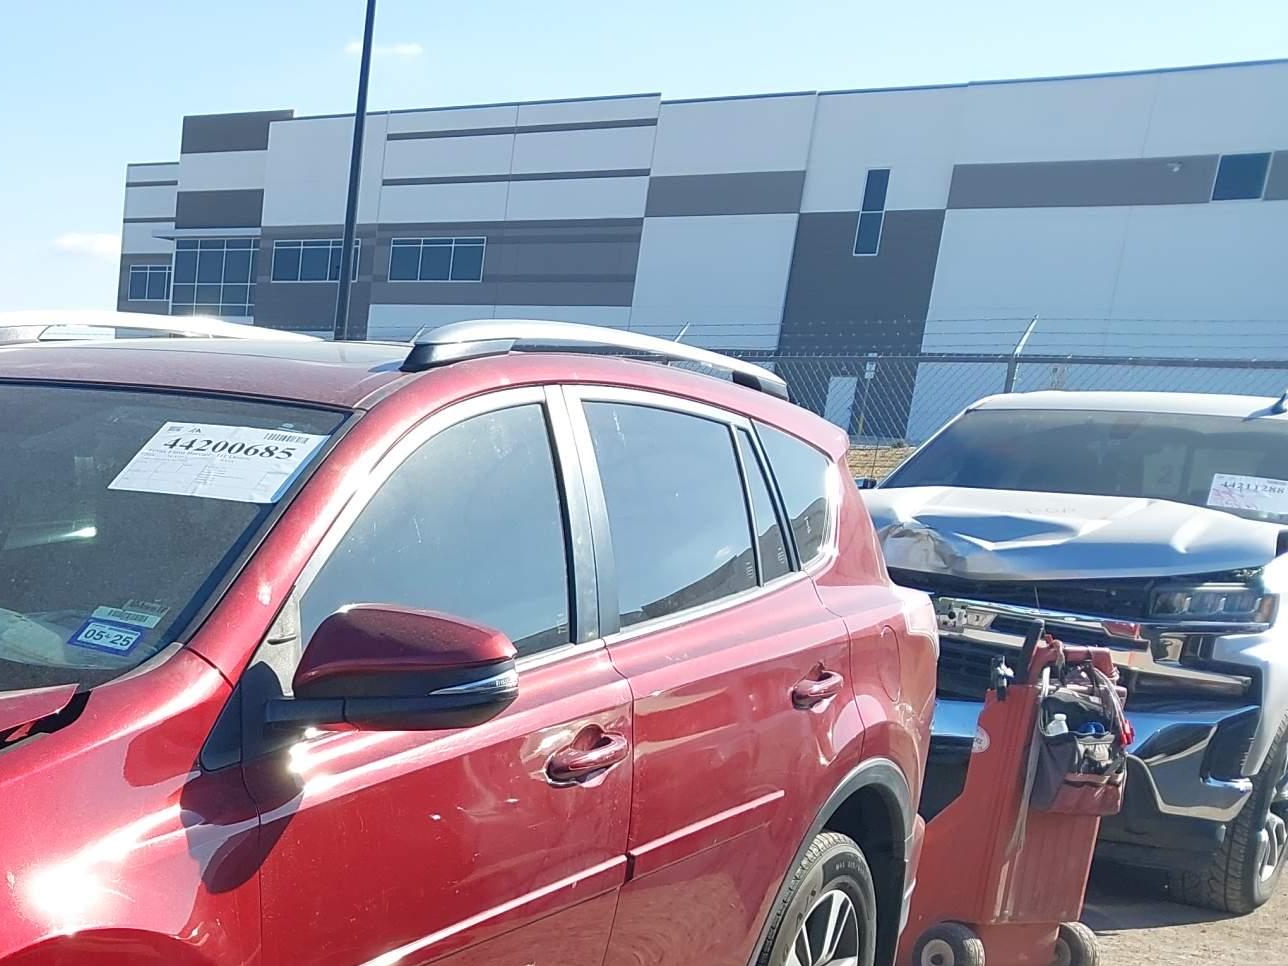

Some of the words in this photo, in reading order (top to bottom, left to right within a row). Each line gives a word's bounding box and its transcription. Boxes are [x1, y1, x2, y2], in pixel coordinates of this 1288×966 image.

[163, 437, 297, 460] 44200685
[84, 629, 106, 641] 05
[109, 634, 133, 647] 25
